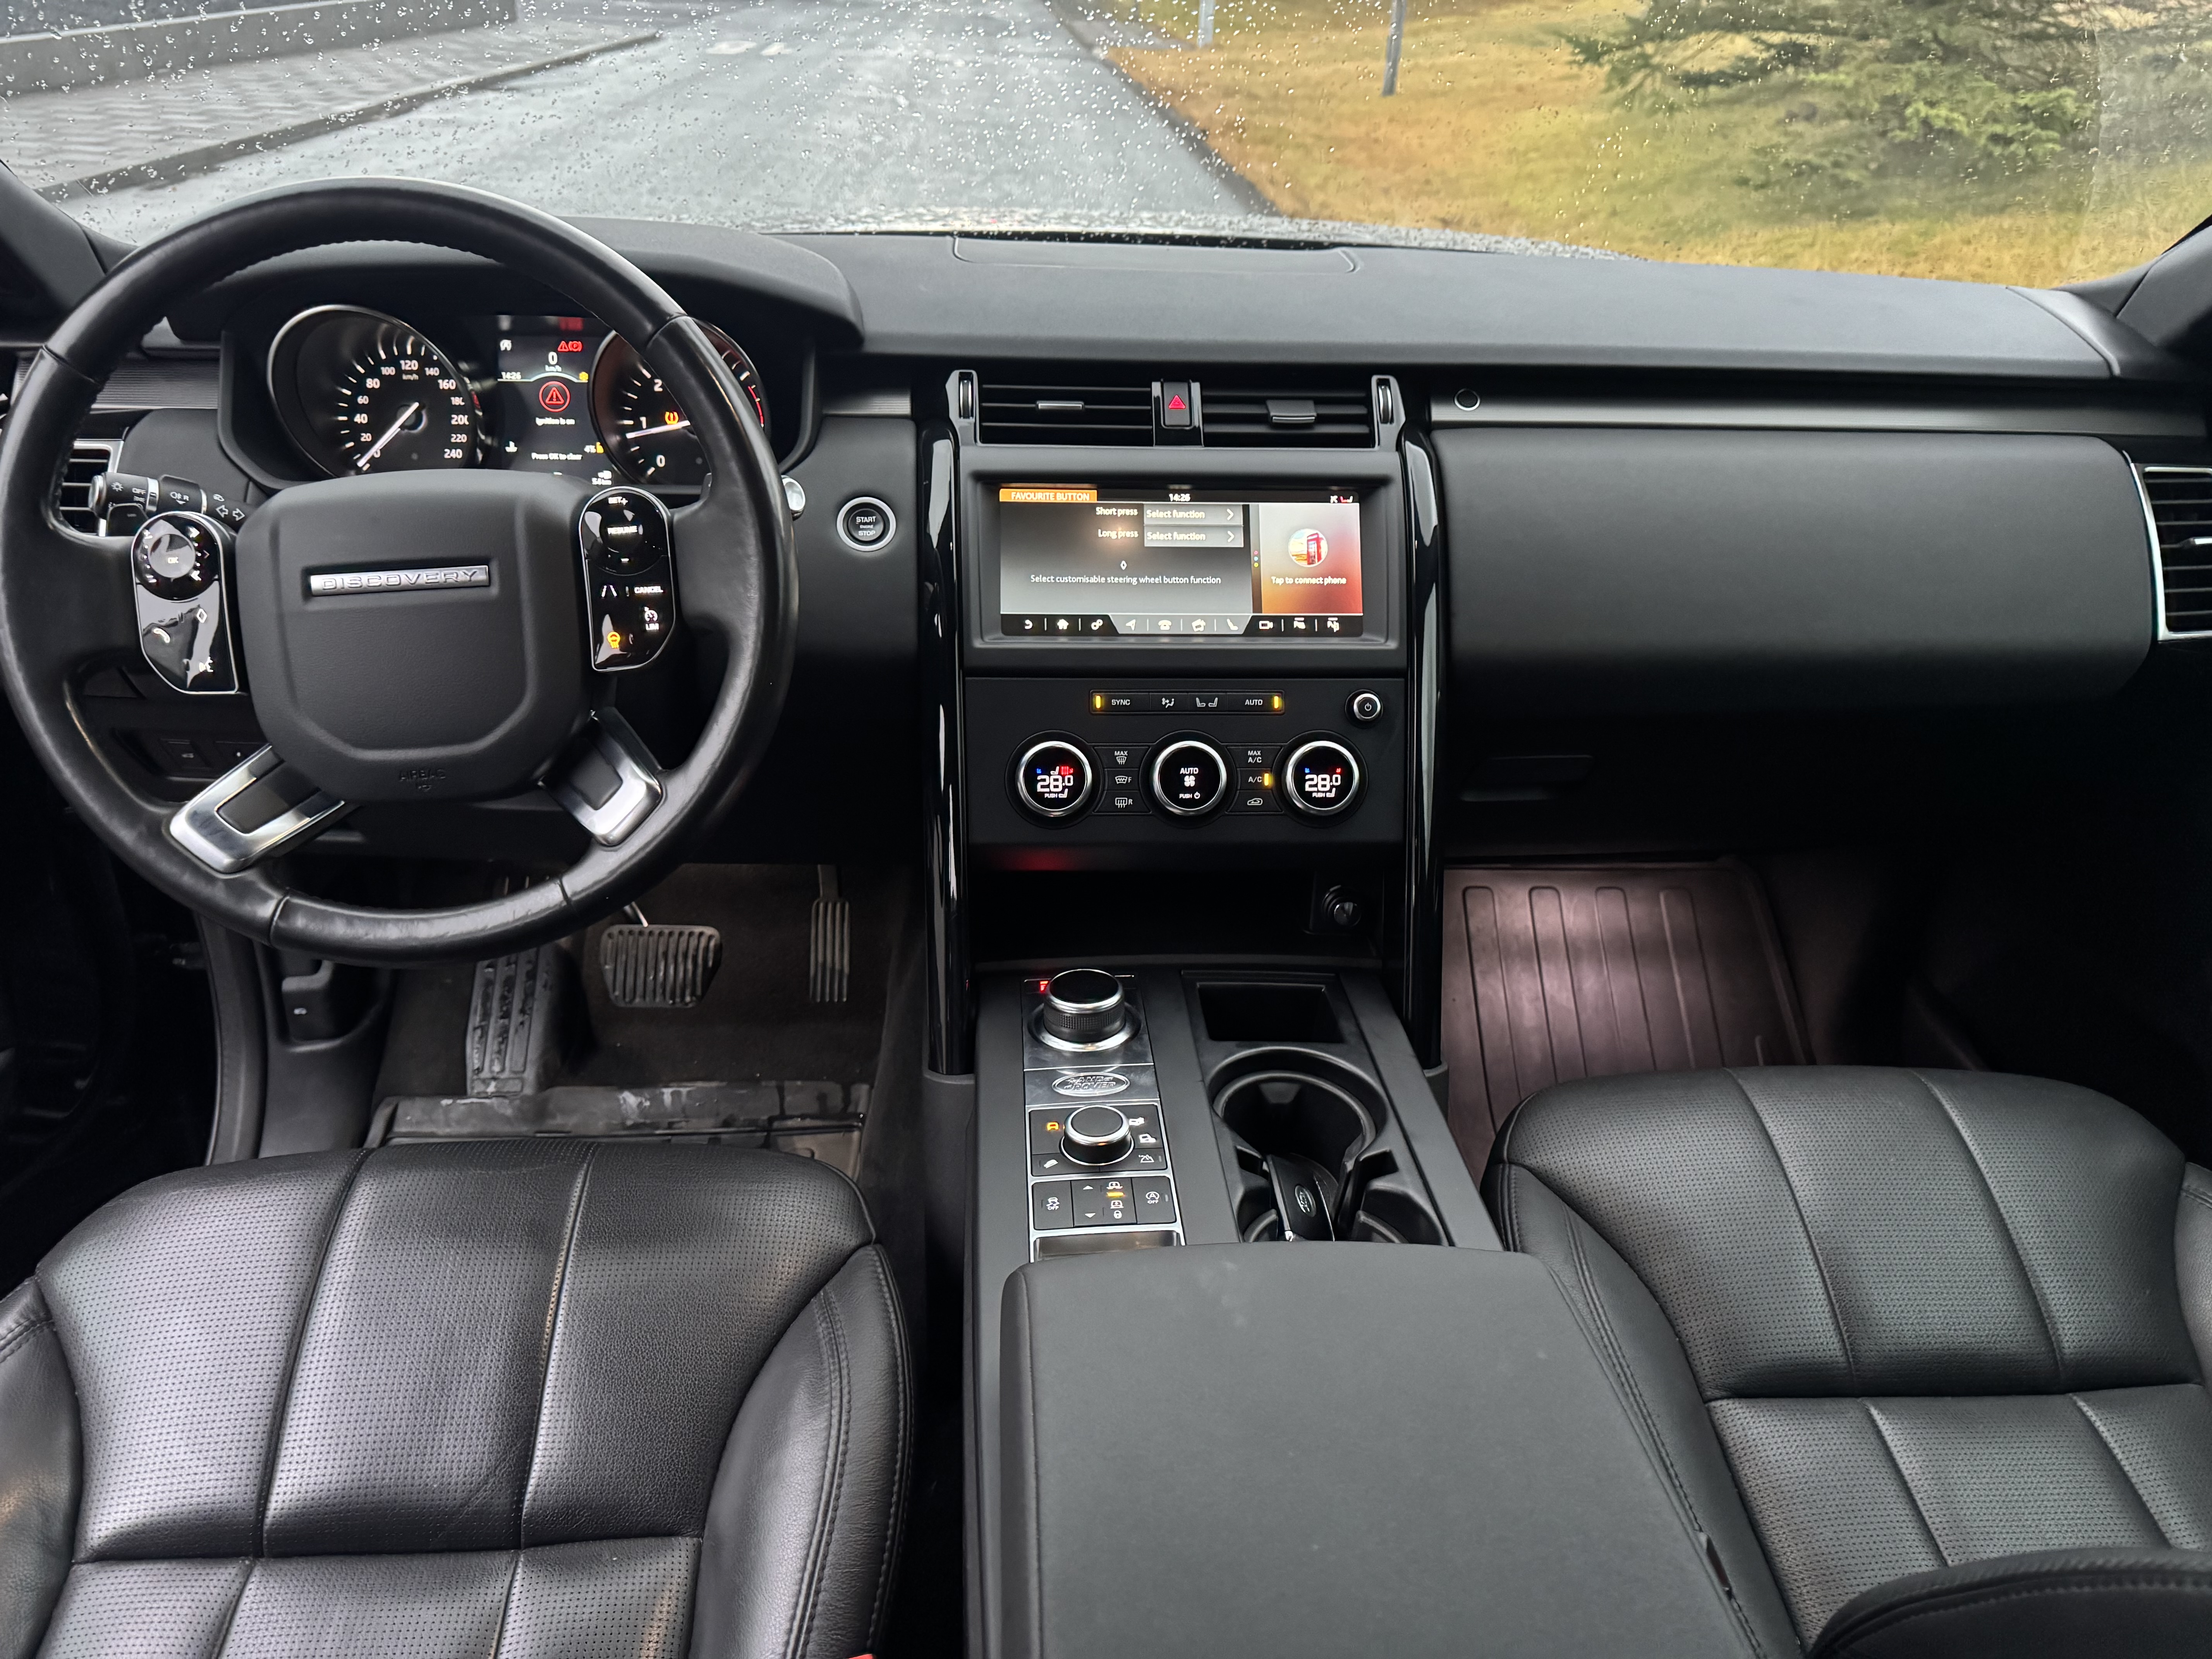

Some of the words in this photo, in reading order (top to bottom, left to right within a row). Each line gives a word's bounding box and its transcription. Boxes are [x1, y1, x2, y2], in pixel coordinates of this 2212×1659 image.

[548, 352, 558, 365] 0
[400, 360, 418, 370] 120
[381, 367, 395, 375] 100
[425, 368, 440, 376] 140
[366, 378, 380, 388] 80
[438, 380, 456, 389] 160
[654, 379, 663, 392] 2
[357, 396, 369, 405] 60
[354, 414, 368, 424] 40
[640, 416, 647, 428] 1
[361, 433, 372, 441] 20
[451, 434, 467, 443] 220
[444, 449, 462, 459] 240
[656, 455, 665, 467] 0
[1011, 492, 1054, 500] FAVOURITE
[1056, 493, 1090, 501] BUTTON
[1168, 493, 1191, 501] 14:26
[1096, 507, 1117, 515] Short
[1117, 508, 1138, 517] press
[1146, 510, 1171, 518] Select
[1173, 510, 1205, 519] function
[608, 526, 637, 534] RESUME
[1098, 529, 1117, 538] Long
[1118, 530, 1139, 539] press
[1147, 532, 1172, 540] Select
[1173, 532, 1206, 541] function
[322, 570, 478, 591] DISCOVERY
[1030, 575, 1054, 583] Select
[1056, 575, 1105, 583] customisable
[1107, 575, 1137, 585] steering
[1139, 575, 1162, 584] wheel
[1163, 576, 1189, 584] button
[1190, 576, 1221, 584] function
[1271, 576, 1284, 586] Tap
[1324, 576, 1346, 586] phone
[1037, 775, 1073, 792] 28.0
[1305, 774, 1341, 791] 28.0
